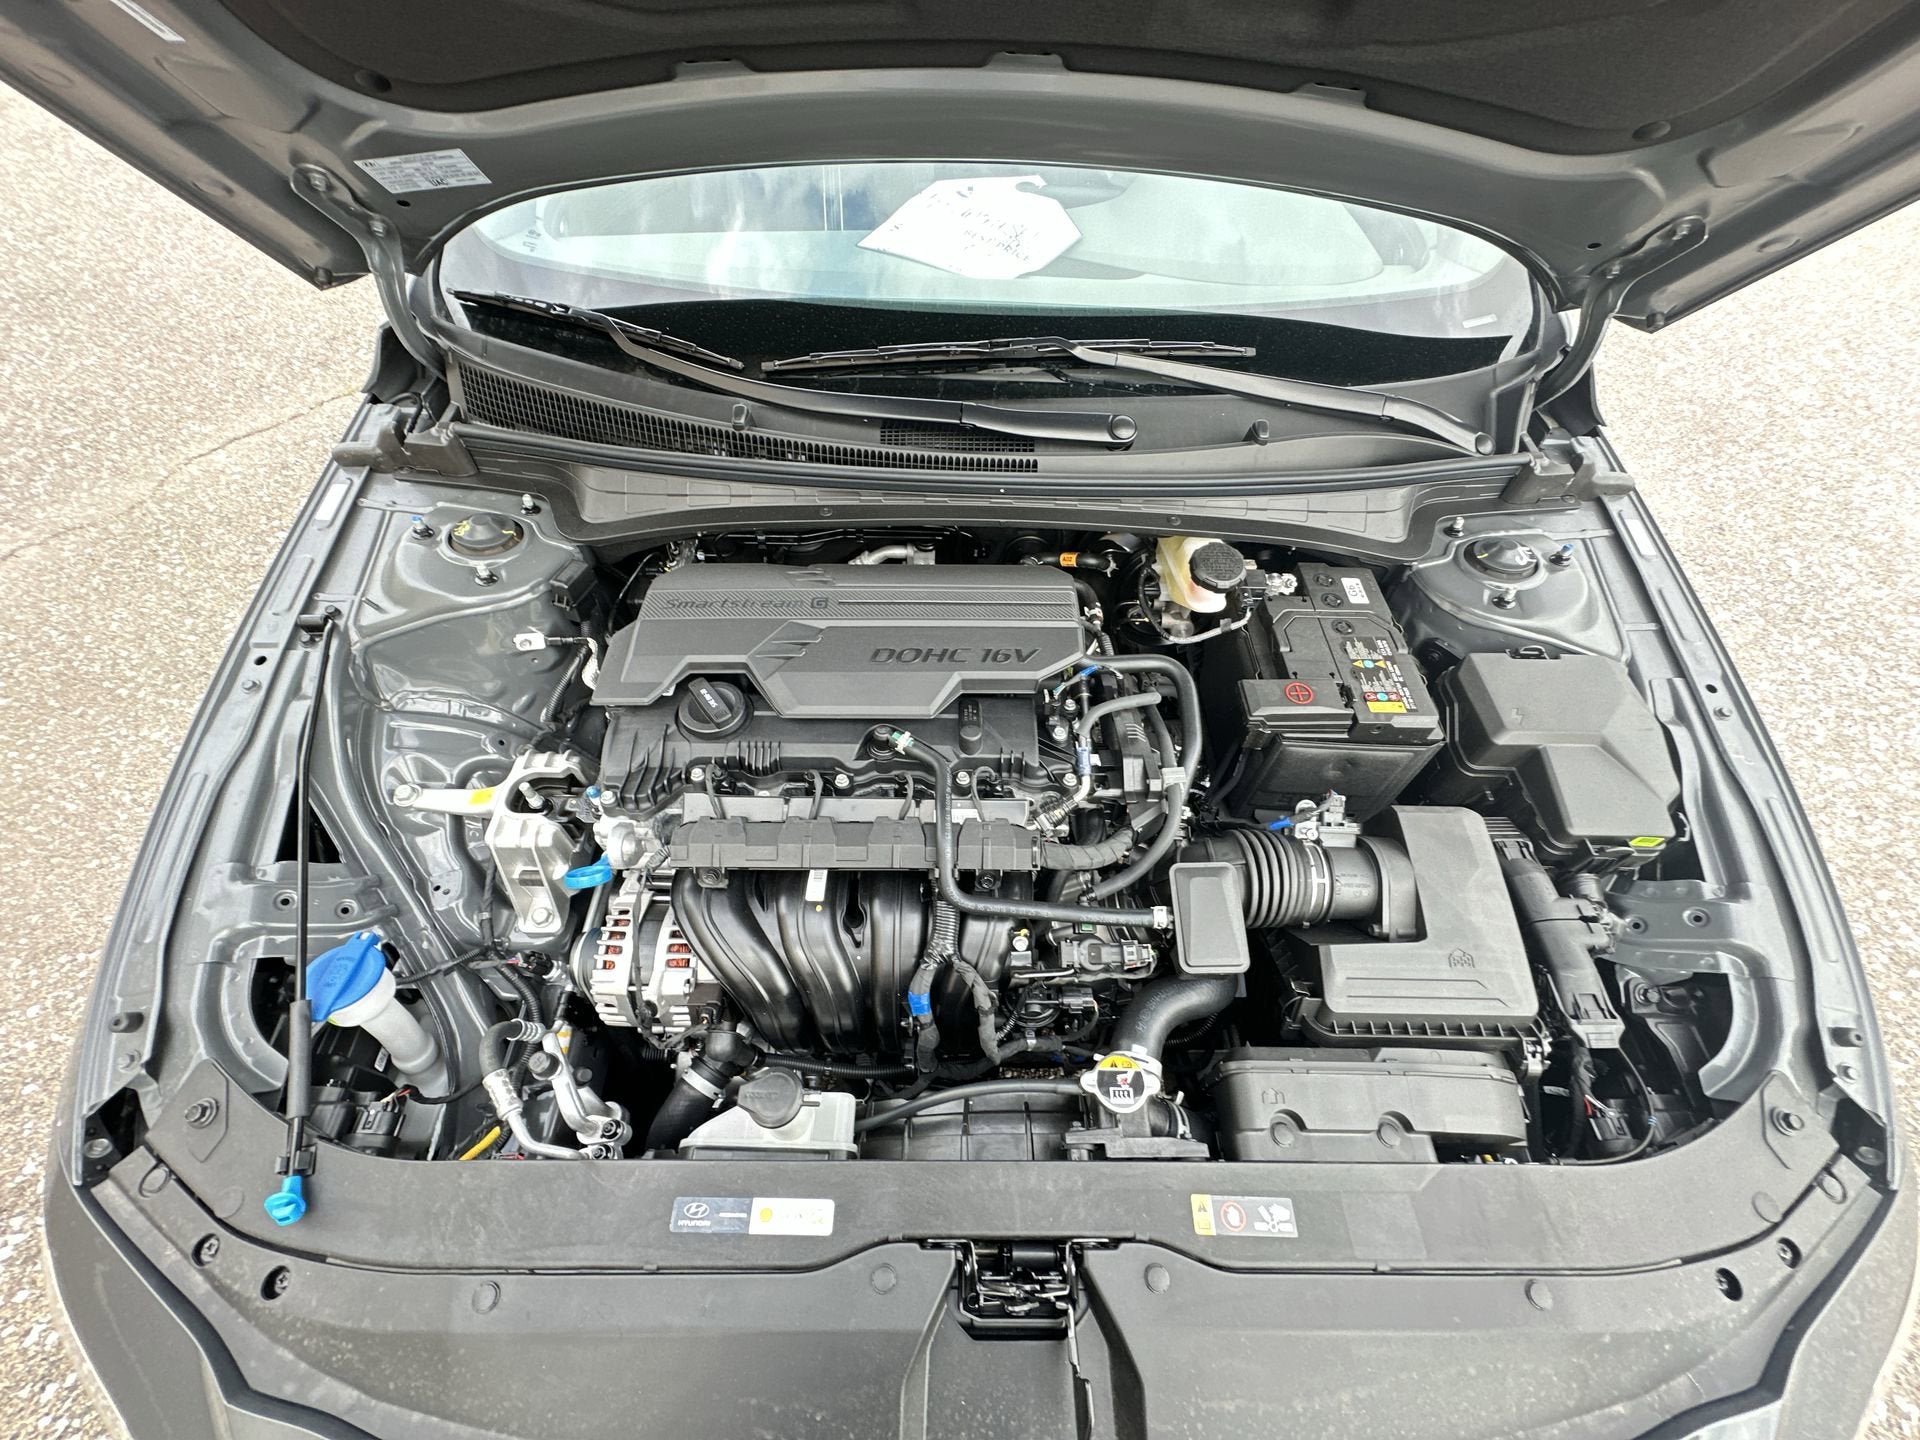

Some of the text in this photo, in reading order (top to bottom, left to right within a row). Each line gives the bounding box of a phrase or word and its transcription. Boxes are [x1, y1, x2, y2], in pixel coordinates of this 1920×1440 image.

[662, 599, 802, 610] Smartstream
[870, 648, 1041, 664] DOHC 16V
[677, 1219, 712, 1227] HYUNDAI
